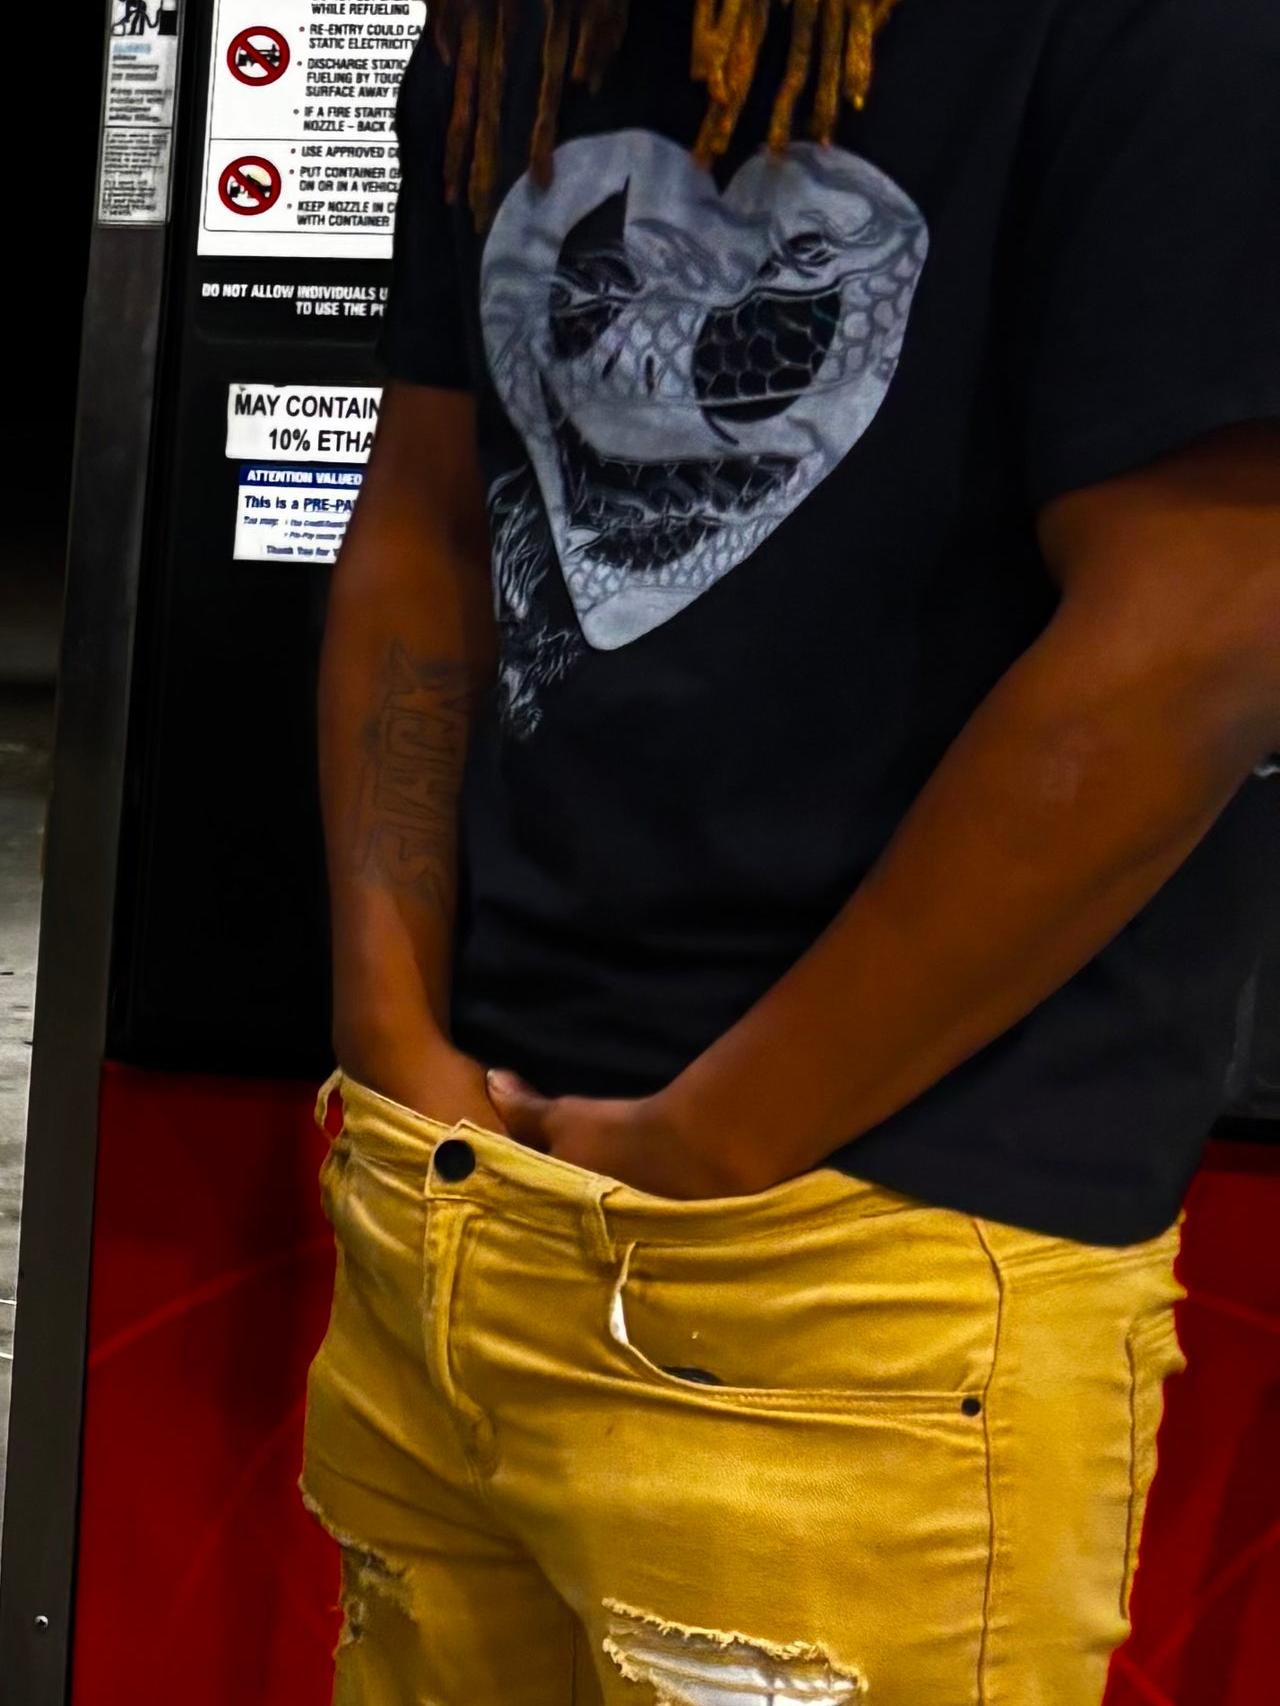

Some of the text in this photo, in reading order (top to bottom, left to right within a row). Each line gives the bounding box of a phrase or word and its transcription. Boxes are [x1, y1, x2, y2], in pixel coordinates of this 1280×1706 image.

[311, 3, 410, 15] WHILE REFUELING
[309, 24, 422, 37] RE-ENTRY COULD CA
[308, 38, 419, 50] STATIC ELECTRICITY
[307, 58, 408, 71] DISCHARGE STATIC
[306, 72, 404, 85] FUELING BY TOUC
[305, 86, 356, 98] SURFACE
[357, 86, 390, 98] AWAY
[304, 106, 315, 117] IF
[317, 106, 325, 117] A
[327, 106, 352, 118] FIRE
[303, 120, 346, 132] NOZZLE
[357, 121, 386, 132] BACK
[301, 146, 323, 158] USE
[325, 146, 385, 158] APPROVED
[299, 166, 322, 178] PUT
[325, 167, 386, 179] CONTAINER
[299, 180, 400, 193] ON OR IN A VEHICL
[297, 201, 325, 212] KEEP
[327, 201, 370, 213] NOZZLE
[372, 202, 384, 213] IN
[297, 214, 391, 227] WITH CONTAINER
[201, 283, 220, 298] DO
[222, 284, 248, 298] NOT
[250, 284, 294, 299] ALLOW
[296, 285, 375, 300] INDIVIDUALS
[295, 301, 313, 315] TO
[314, 301, 340, 316] USE
[342, 302, 368, 316] THE
[234, 393, 381, 419] MAY CONTAIN
[268, 428, 376, 453] 10% ETHA
[246, 469, 363, 486] ATTENTION VALUED
[244, 495, 356, 512] This is a PRE-PA
